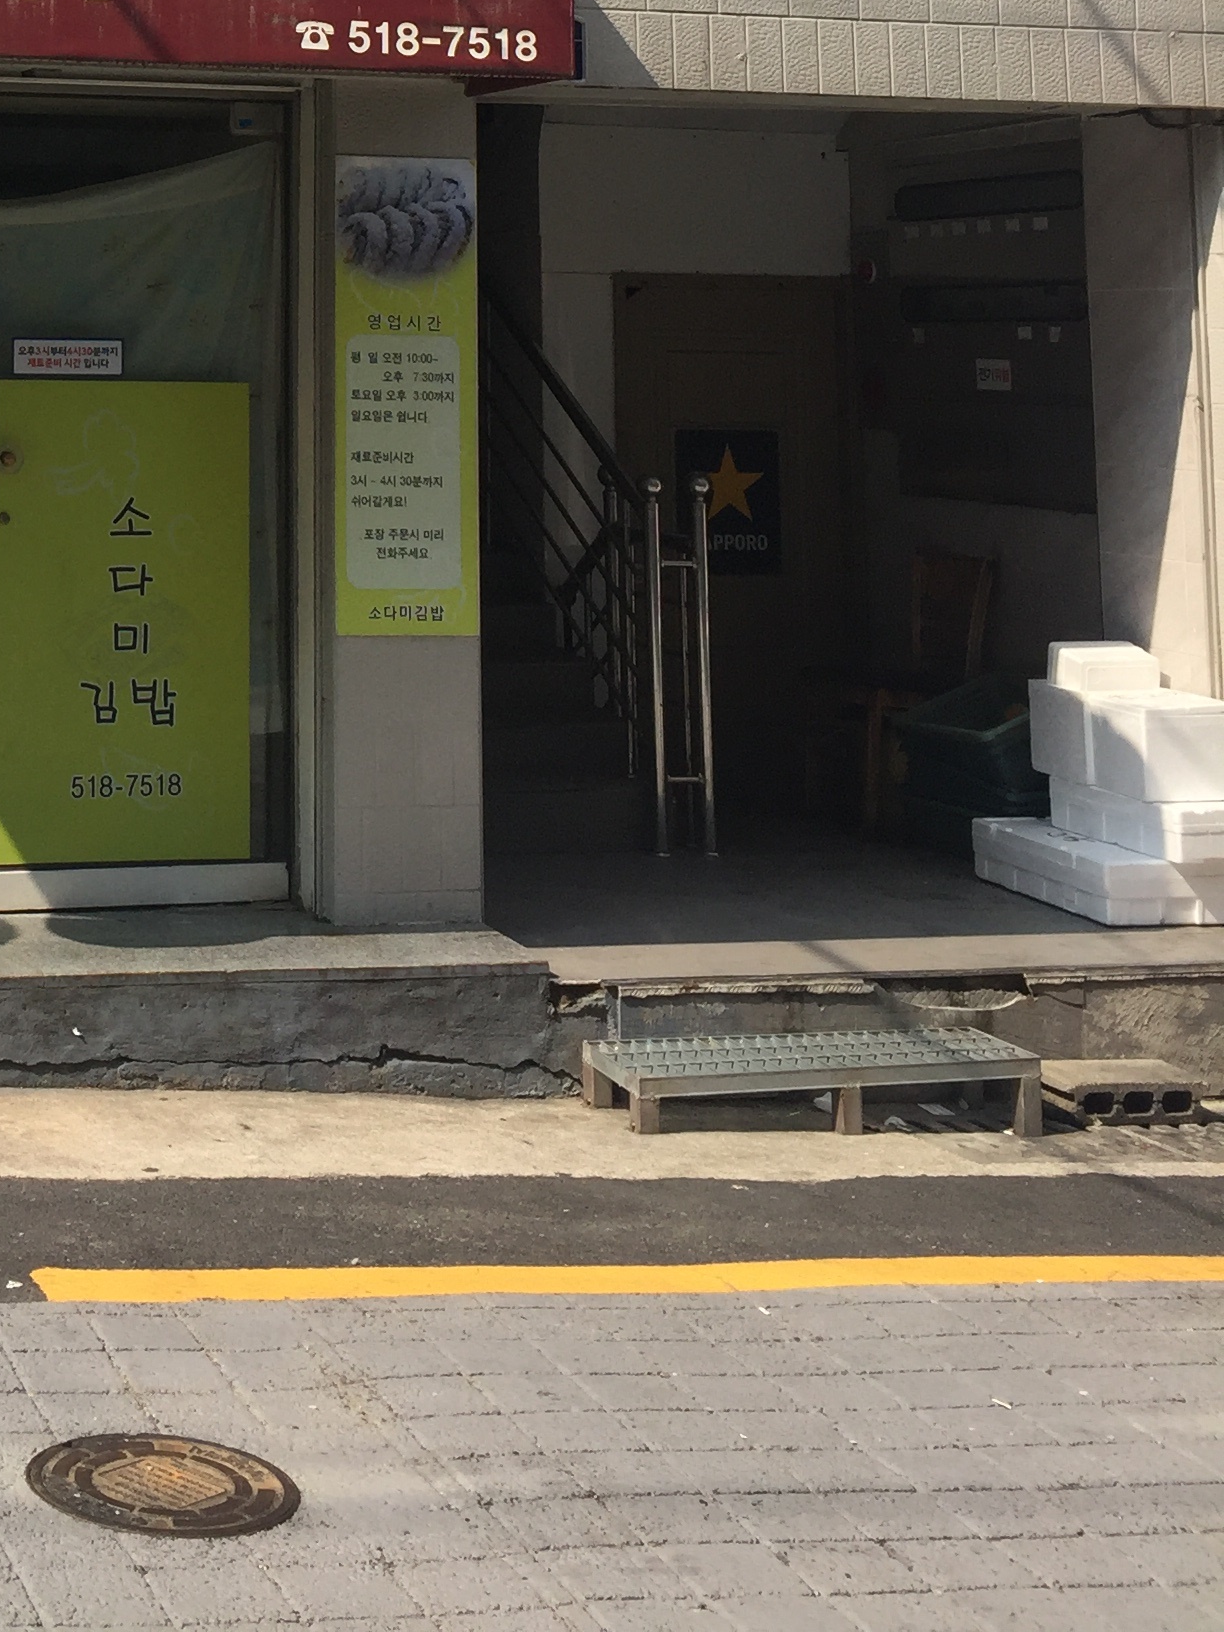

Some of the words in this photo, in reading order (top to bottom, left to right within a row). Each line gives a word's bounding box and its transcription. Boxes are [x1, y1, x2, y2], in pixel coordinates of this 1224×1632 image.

[347, 19, 538, 62] 518-7518
[367, 313, 442, 332] 영업시간
[64, 358, 81, 369] 시간
[83, 359, 110, 369] 입니다
[382, 351, 402, 365] 오전
[382, 370, 404, 383] 오후
[350, 389, 382, 402] 토요일
[386, 389, 407, 403] 오후
[350, 451, 414, 464] 재료준비시간
[350, 475, 367, 488] 3시
[380, 475, 397, 488] 4시
[399, 475, 443, 489] 30분까지
[388, 528, 420, 541] 주문시
[423, 529, 445, 541] 미리
[708, 534, 769, 551] PPORO
[368, 605, 445, 622] 소다미김밥
[80, 678, 177, 727] 김밥
[70, 773, 182, 799] 518-7518
